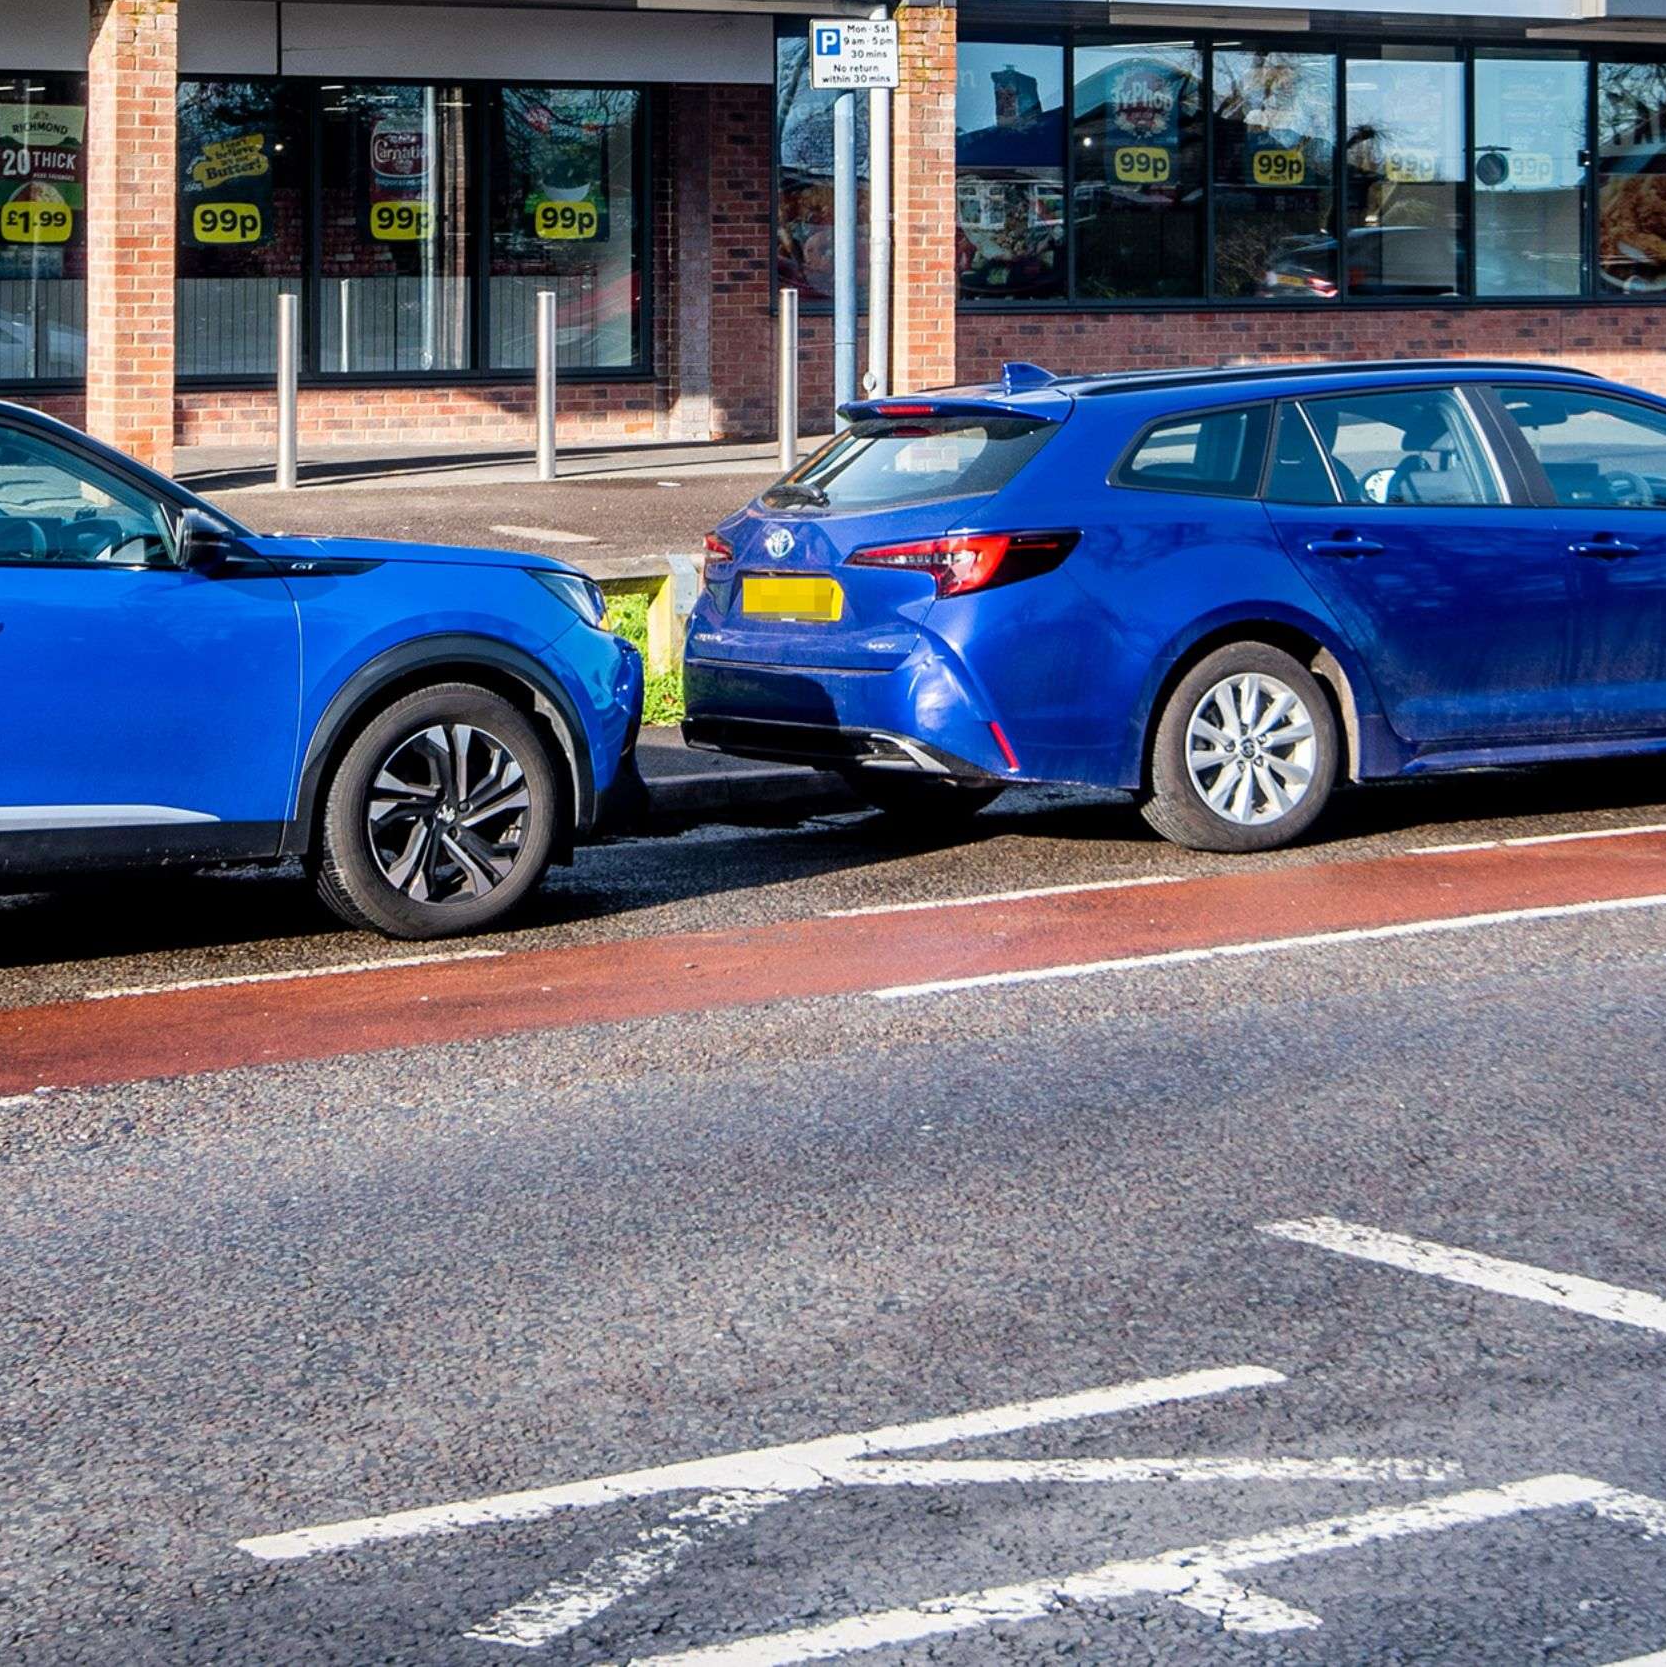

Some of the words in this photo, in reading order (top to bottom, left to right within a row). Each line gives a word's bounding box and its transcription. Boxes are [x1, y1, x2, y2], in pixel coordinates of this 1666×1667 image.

[847, 25, 867, 33] Mon
[874, 25, 890, 33] Sat
[851, 50, 864, 58] 30
[866, 49, 887, 58] mins
[822, 75, 850, 83] within
[854, 75, 867, 83] 30
[834, 64, 846, 73] No
[850, 64, 879, 73] return
[3, 149, 31, 175] 20
[33, 151, 77, 170] THICK
[374, 139, 432, 163] Carnatio
[1119, 152, 1167, 177] 99p
[1257, 154, 1302, 180] 99p
[6, 210, 67, 234] £1.99
[200, 209, 258, 238] 99p
[376, 206, 430, 236] 99p
[541, 207, 594, 235] 99p
